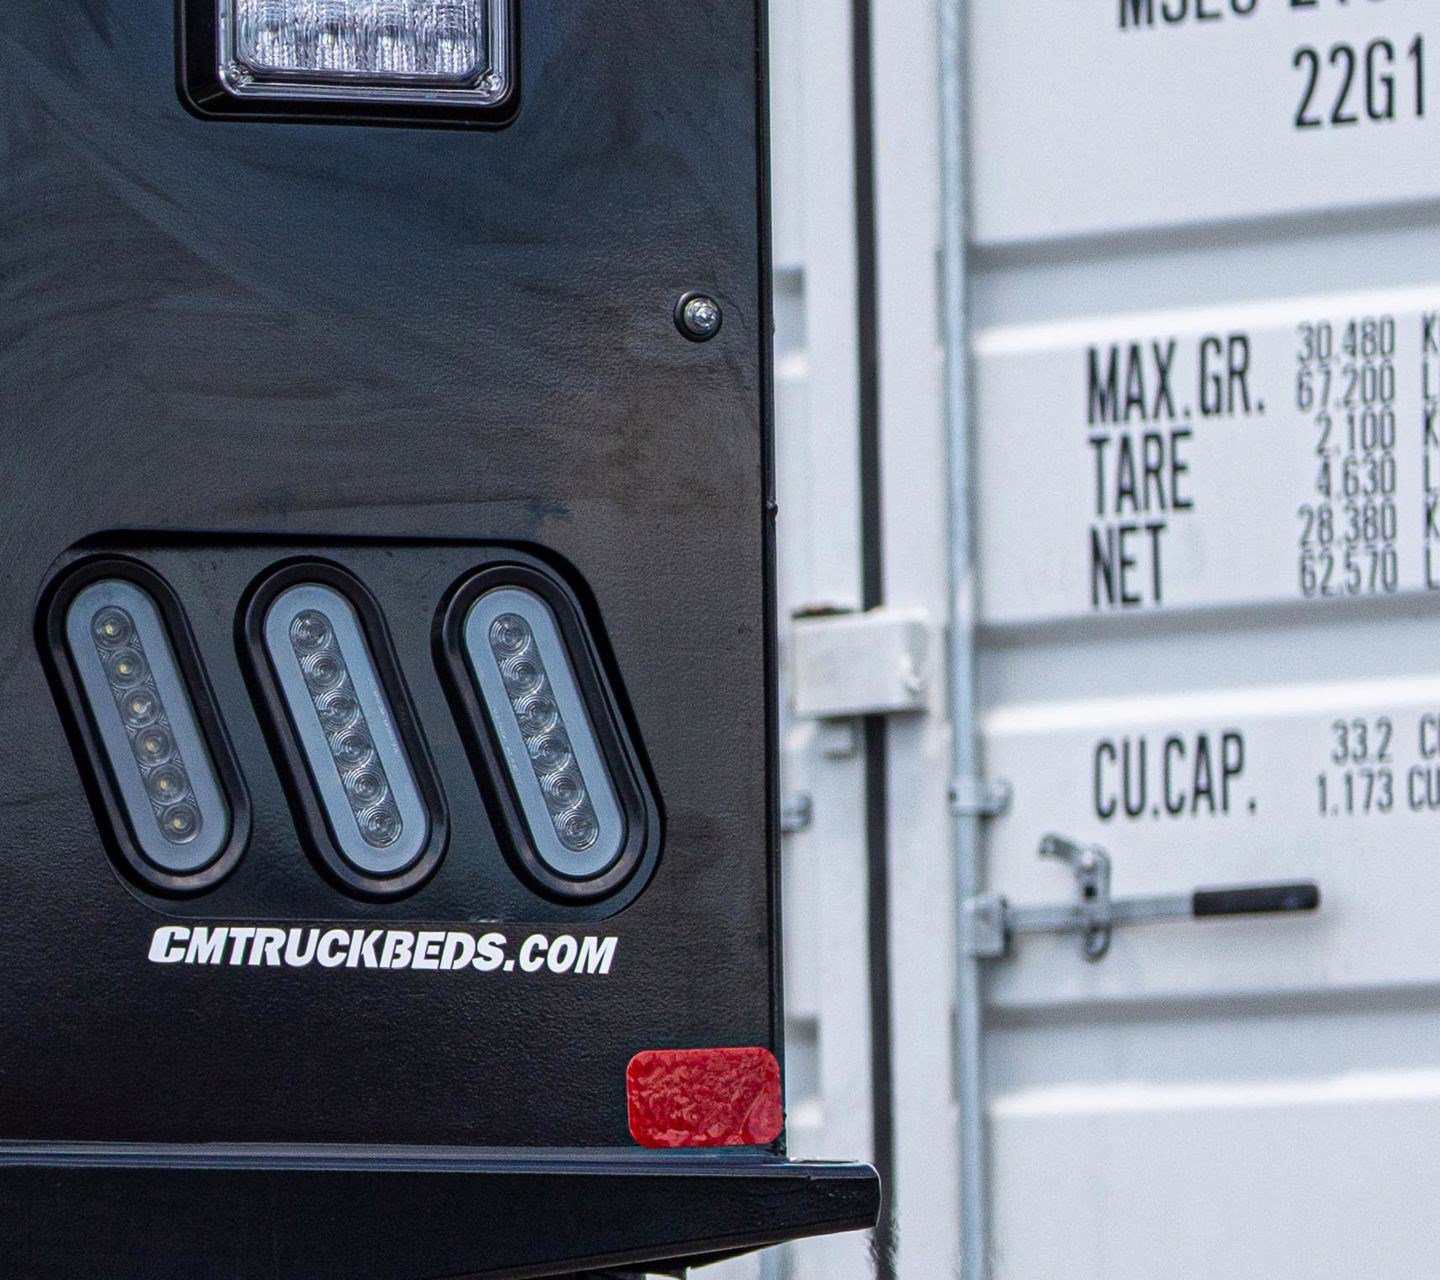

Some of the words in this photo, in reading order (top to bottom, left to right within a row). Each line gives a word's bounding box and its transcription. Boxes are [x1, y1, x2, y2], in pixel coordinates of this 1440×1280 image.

[1293, 33, 1424, 129] 22G1
[1089, 428, 1194, 517] TARE
[1090, 521, 1167, 609] NET
[147, 925, 620, 976] CMTRUCKBEDS.COM
